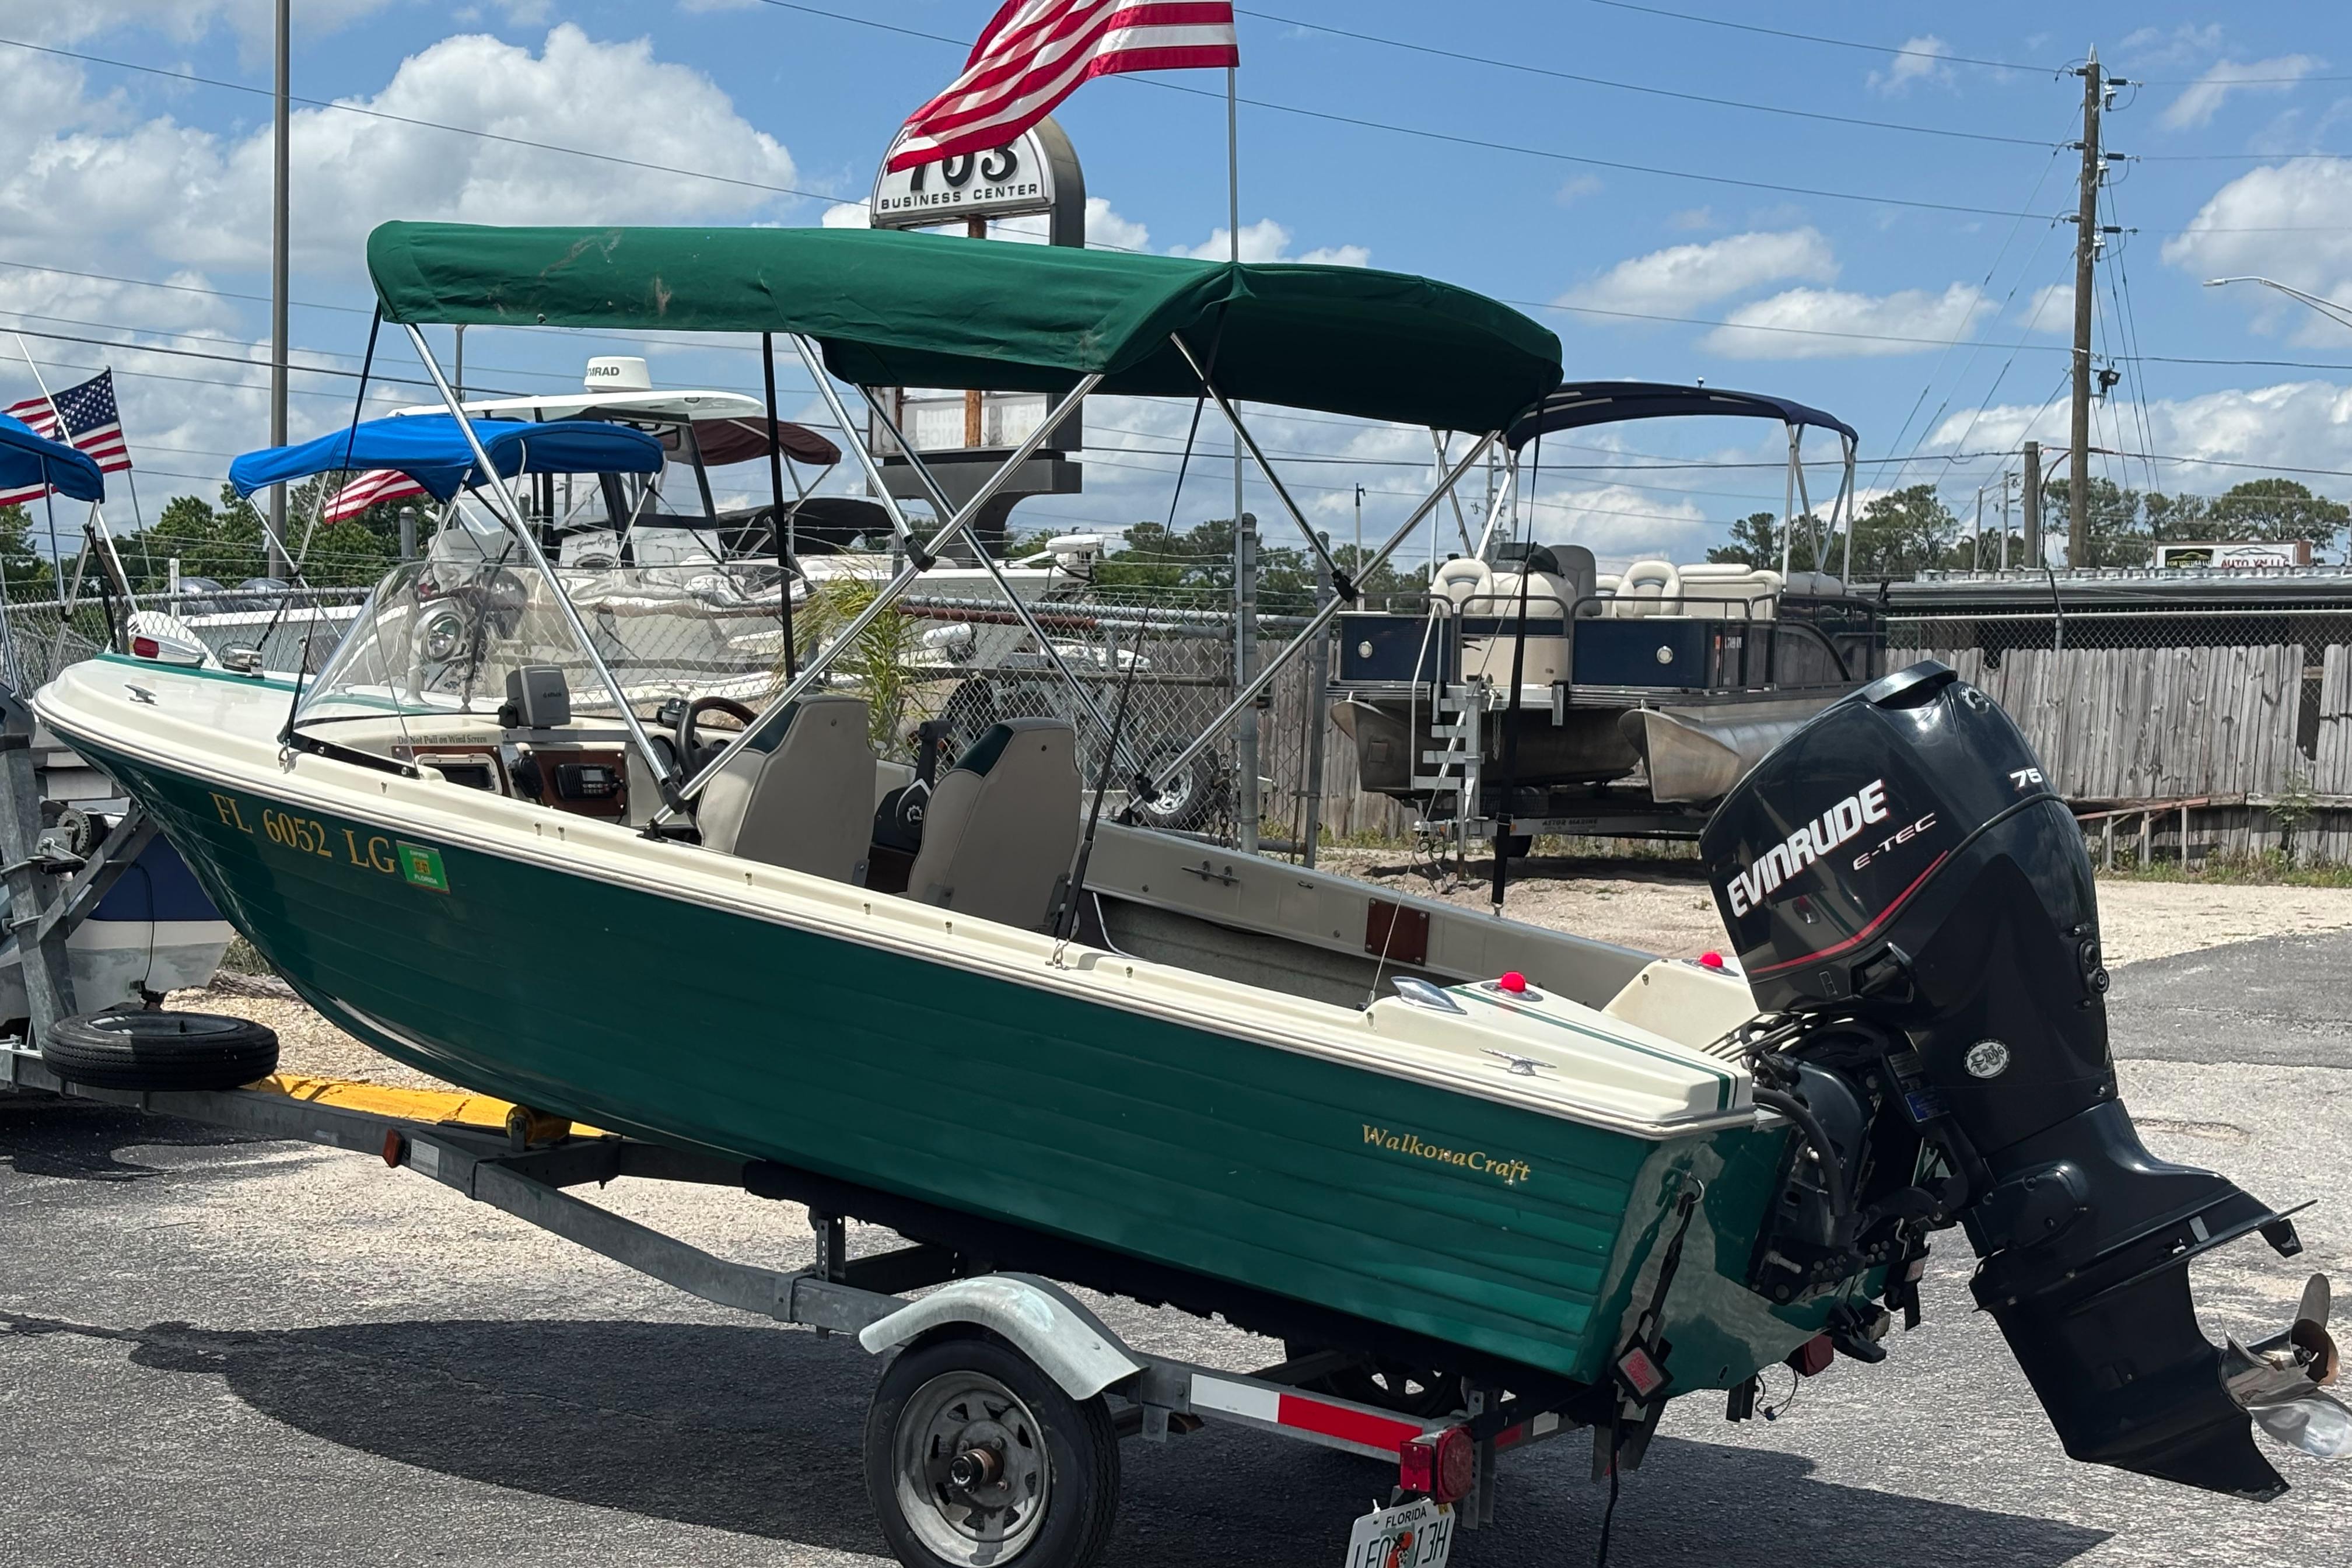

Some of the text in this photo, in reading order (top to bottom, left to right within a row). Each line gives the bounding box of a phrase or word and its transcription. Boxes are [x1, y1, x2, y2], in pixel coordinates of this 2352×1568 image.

[881, 184, 1038, 209] BUSINESS CENTER
[397, 736, 408, 744] Do
[410, 736, 423, 744] Not
[424, 735, 438, 744] Pull
[448, 734, 466, 744] Wind
[467, 734, 487, 743] Screen
[2010, 768, 2043, 788] 75
[208, 792, 396, 874] FL 6052 LG
[1853, 811, 1937, 872] E-TEC
[1727, 779, 1889, 918] EVINRUDE
[414, 874, 438, 885] FLORIDA
[1362, 1124, 1531, 1185] WalkonaCraft
[1385, 1506, 1427, 1528] FLORIDA
